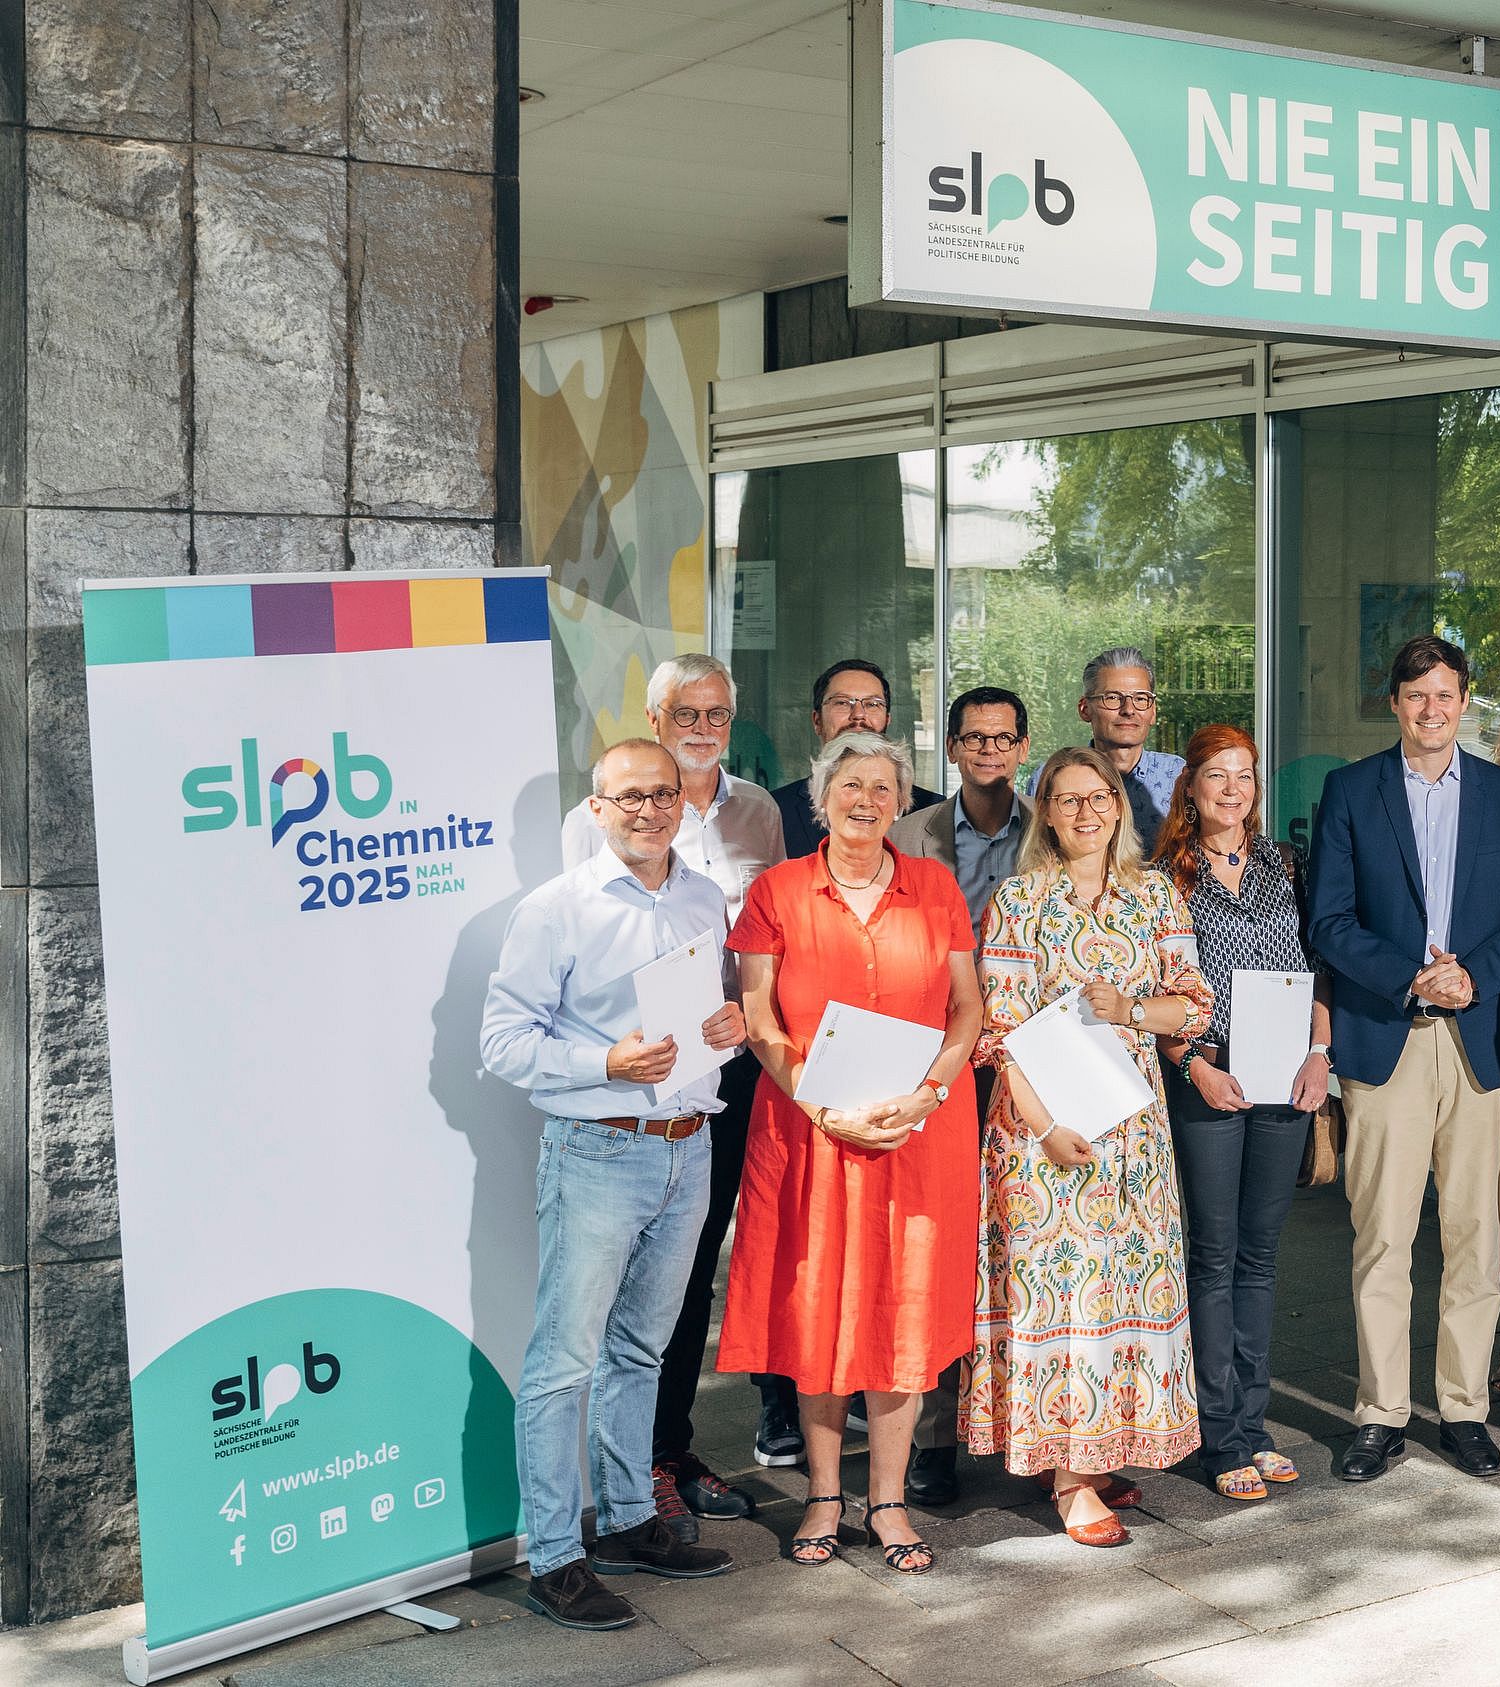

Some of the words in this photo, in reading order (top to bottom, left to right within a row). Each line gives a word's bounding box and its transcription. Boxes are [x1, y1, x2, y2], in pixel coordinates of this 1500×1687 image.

[1187, 86, 1334, 192] NIE
[1358, 110, 1491, 210] EIN
[928, 151, 1075, 234] slpb
[928, 221, 983, 236] SÄCHSISCHE
[928, 235, 1006, 251] LANDESZENTRALE
[1007, 241, 1025, 253] FÜR
[1186, 194, 1490, 310] SEITIG
[928, 248, 980, 261] POLITISCHE
[981, 253, 1020, 265] BILDUNG
[181, 732, 393, 848] slpb
[399, 799, 418, 815] IN
[296, 814, 494, 867] Chemnitz
[299, 864, 411, 912] 2025
[416, 862, 454, 879] NAH
[417, 877, 465, 897] DRAN
[211, 1341, 341, 1423] slpb
[213, 1418, 262, 1438] SÄCHSISCHE
[214, 1423, 283, 1449] LANDESZENTRALE
[284, 1418, 300, 1429] FÜR
[215, 1440, 260, 1460] POLITISCHE
[261, 1430, 296, 1446] BILDUNG
[262, 1442, 401, 1498] www.slpb.de
